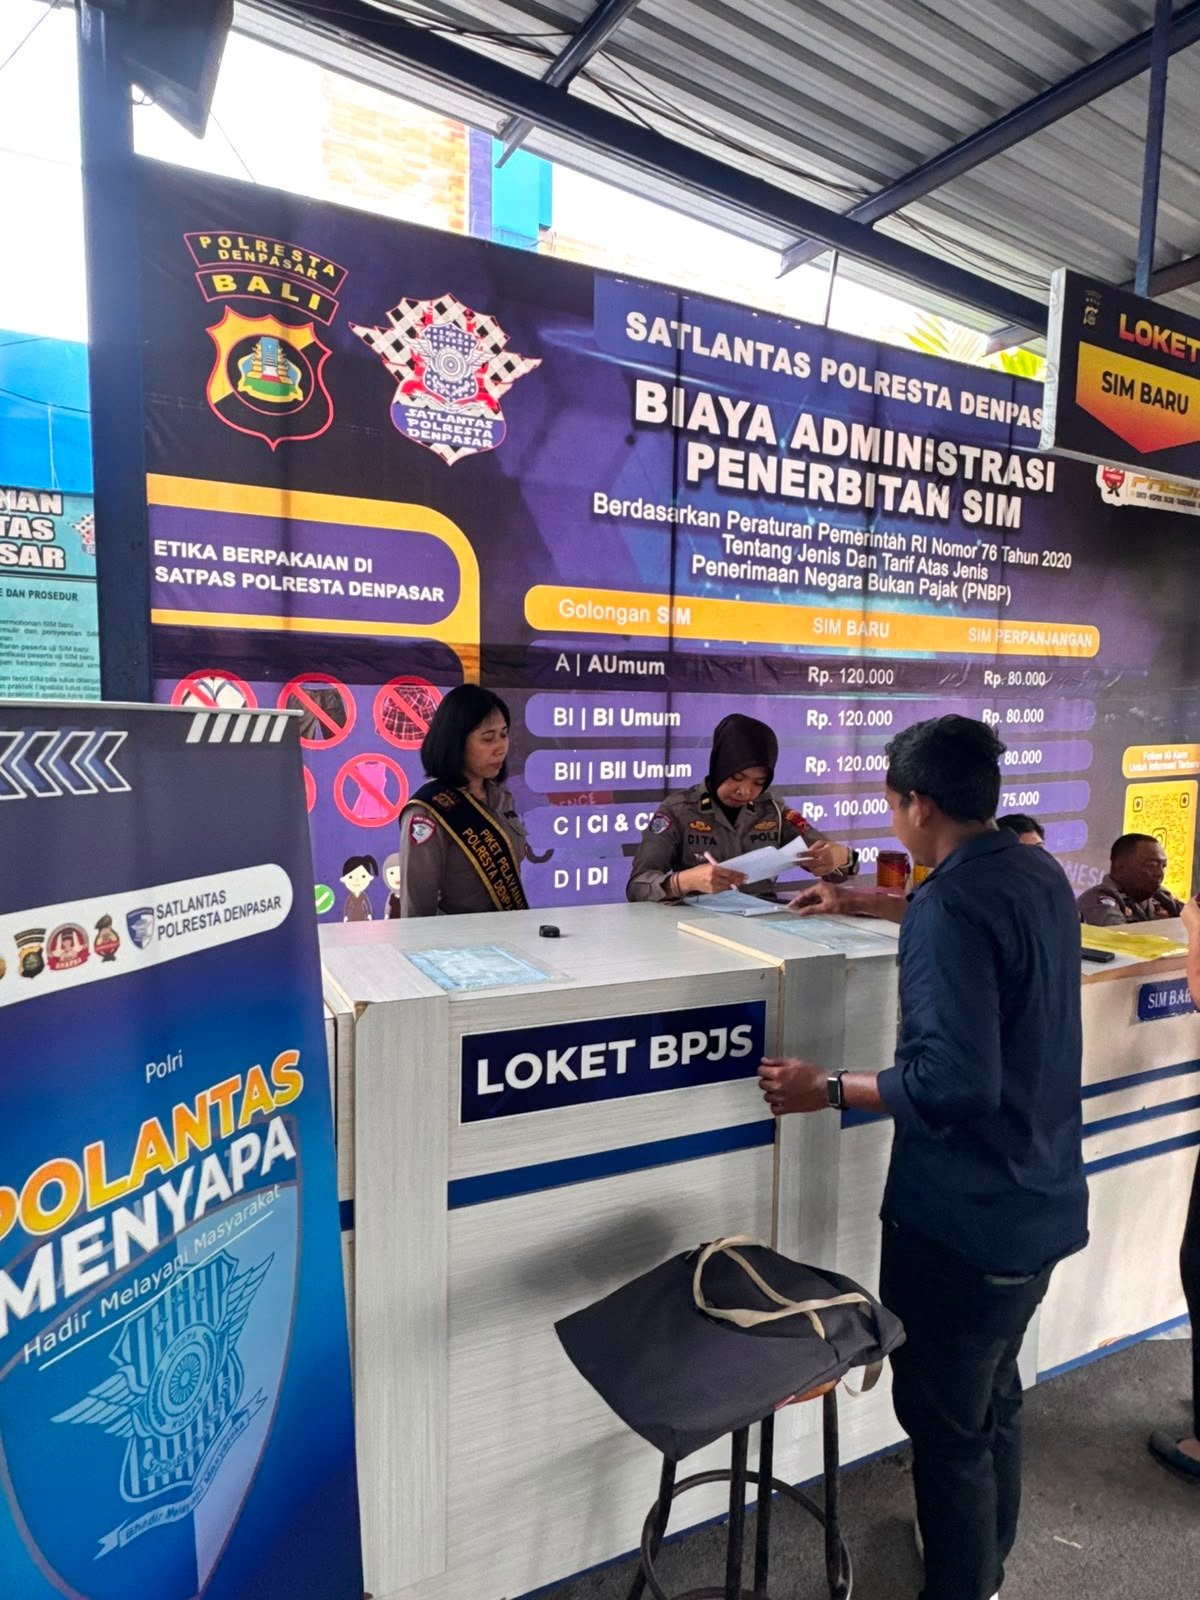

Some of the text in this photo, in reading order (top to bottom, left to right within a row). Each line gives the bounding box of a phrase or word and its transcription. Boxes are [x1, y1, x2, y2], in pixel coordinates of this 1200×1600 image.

[199, 236, 335, 277] POLRESTA
[218, 249, 318, 280] DENPASAR
[212, 274, 321, 310] BALI
[1119, 313, 1200, 363] LOKET
[626, 312, 811, 379] SATLANTAS
[820, 358, 952, 412] POLRESTA
[1101, 371, 1189, 415] SIM BARU
[404, 408, 494, 430] SATLANTAS
[406, 417, 494, 439] POLRESTA
[406, 428, 494, 448] DENPASAR
[635, 379, 1055, 493] BIAYA ADMINISTRASI
[687, 442, 1022, 529] PENERBITAN SIM
[593, 492, 1072, 569] Berdasarkan Peraturan Pemerintah RI Nomor 76 Tahun 2020
[154, 540, 373, 573] ETIKA BERPAKAIAN DI
[722, 534, 988, 580] Tentang Jenis Dan Tarif Atas Jenis
[155, 565, 445, 602] SATPAS POLRESTA DENPASAR
[692, 555, 1012, 605] Penerimaan Negara Bukan Pajak (PNBP)
[6, 588, 25, 598] DAN
[28, 589, 78, 602] PROSEDUR
[559, 599, 691, 625] Golongan SIM
[813, 617, 890, 639] SIM BARU
[968, 627, 1093, 648] SIM PERPANJANGAN
[555, 653, 570, 672] A
[808, 666, 894, 686] Rp. 120.000
[984, 670, 1045, 688] Rp. 80.000
[553, 707, 573, 726] BI
[593, 707, 613, 727] BI
[620, 707, 680, 727] Umum
[807, 709, 893, 730] Rp. 120.000
[982, 707, 1044, 726] Rp. 80.000
[554, 762, 581, 780] BII
[600, 761, 626, 780] BII
[633, 760, 692, 779] Umum
[805, 754, 889, 776] Rp. 120.000
[1005, 749, 1042, 765] 80.000
[803, 798, 888, 821] Rp. 100.000
[1002, 791, 1039, 807] 75.000
[553, 816, 569, 835] C
[587, 814, 608, 833] CI
[614, 813, 629, 832] &
[462, 827, 498, 880] POLRESTA
[480, 828, 503, 856] PIKET
[554, 870, 569, 888] D
[588, 867, 608, 886] DI
[156, 890, 227, 920] SATLANTAS
[157, 895, 282, 941] POLRESTA DENPASAR
[1148, 991, 1167, 1009] SIM
[146, 1050, 183, 1084] Polri
[476, 1024, 753, 1096] LOKET BPJS
[0, 1116, 297, 1340] MENYAPA
[23, 1183, 281, 1365] Hadir Melayani Masyarakat
